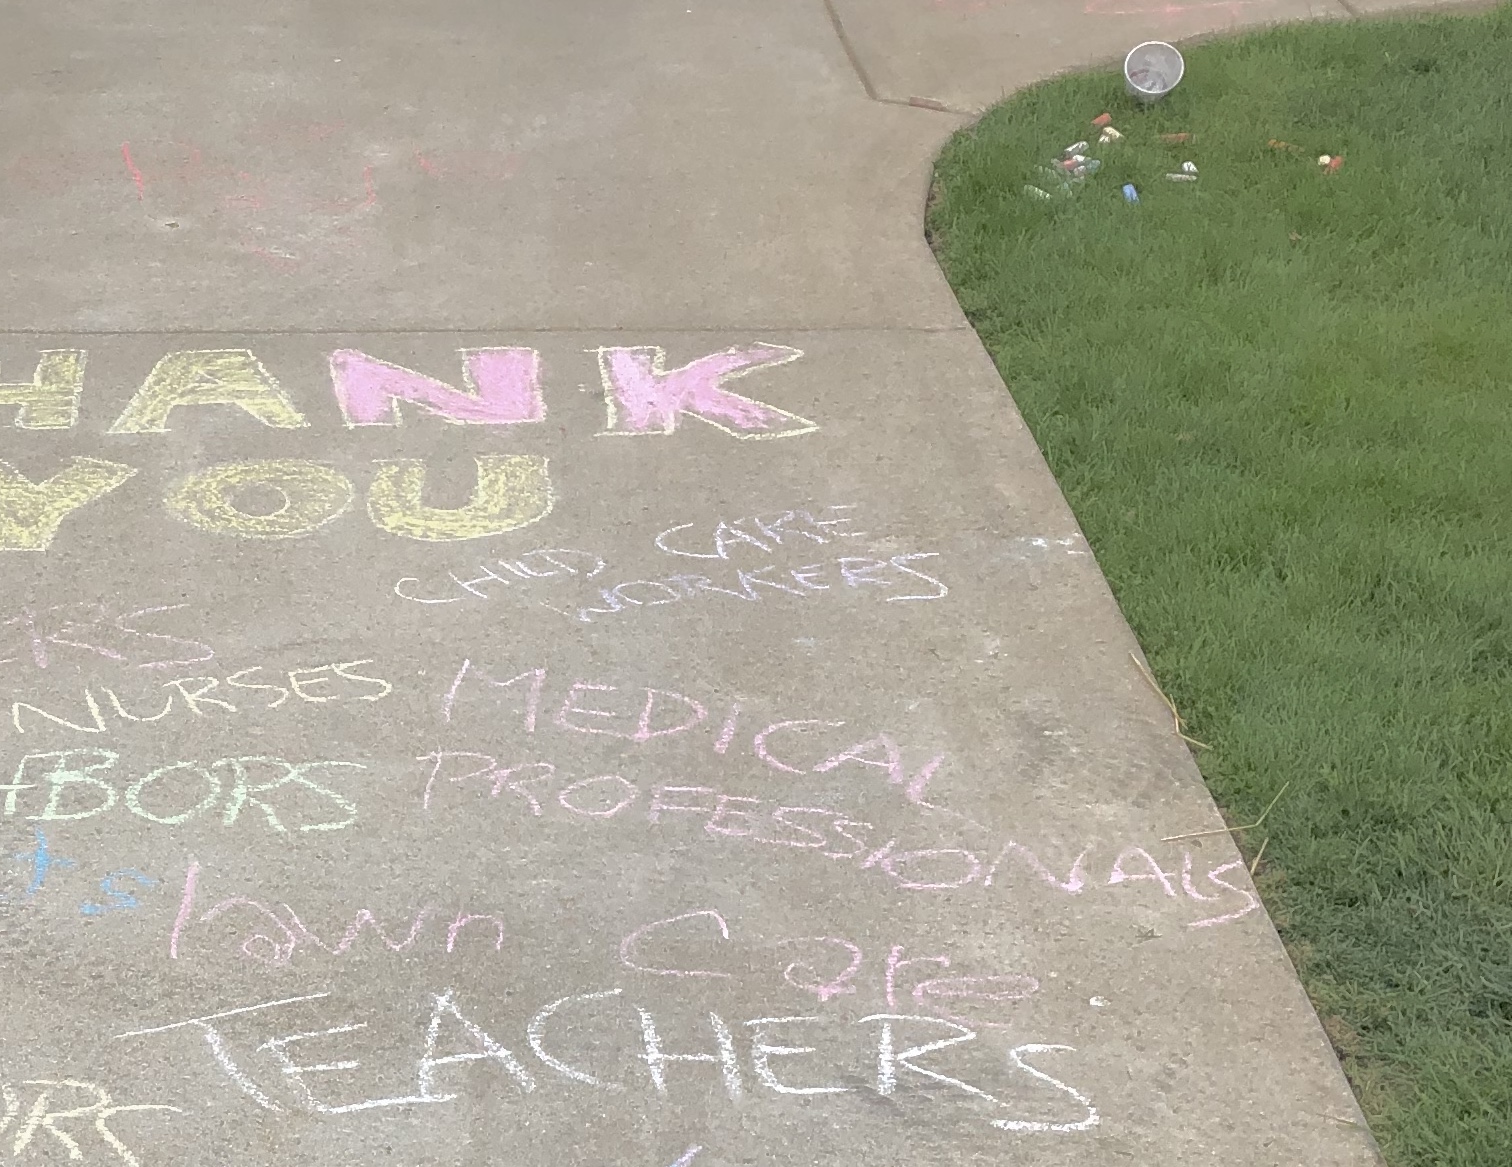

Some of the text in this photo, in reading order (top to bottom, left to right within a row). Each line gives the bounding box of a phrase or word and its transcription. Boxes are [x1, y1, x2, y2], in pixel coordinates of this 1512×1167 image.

[655, 505, 866, 559] CARE
[540, 552, 949, 622] WORKERS
[13, 659, 394, 734] NURSES
[444, 659, 973, 820] MEDICAL
[416, 747, 1260, 928] PROFESSIONALS
[114, 988, 1100, 1131] TEACHERS
